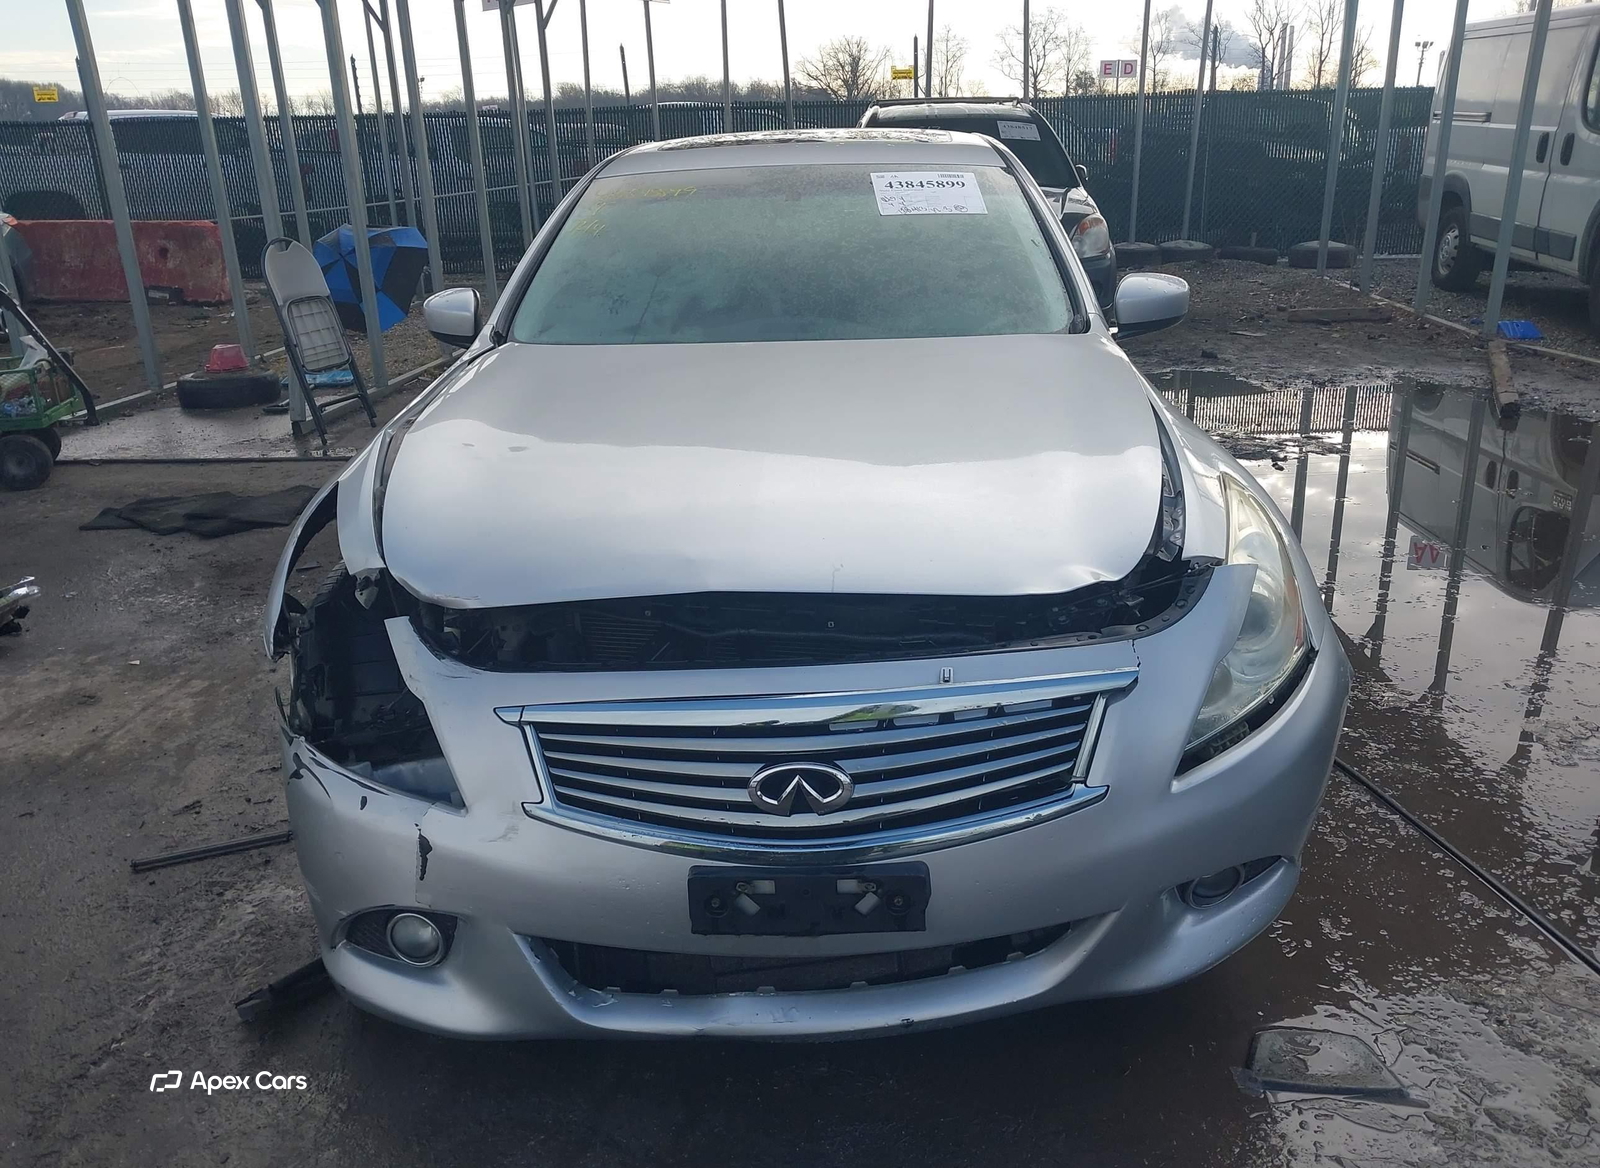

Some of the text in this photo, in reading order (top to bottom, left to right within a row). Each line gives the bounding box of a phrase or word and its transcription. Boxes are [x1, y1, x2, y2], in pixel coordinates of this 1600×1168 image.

[1103, 63, 1113, 75] E
[1123, 63, 1133, 75] D
[884, 180, 966, 189] 43845899
